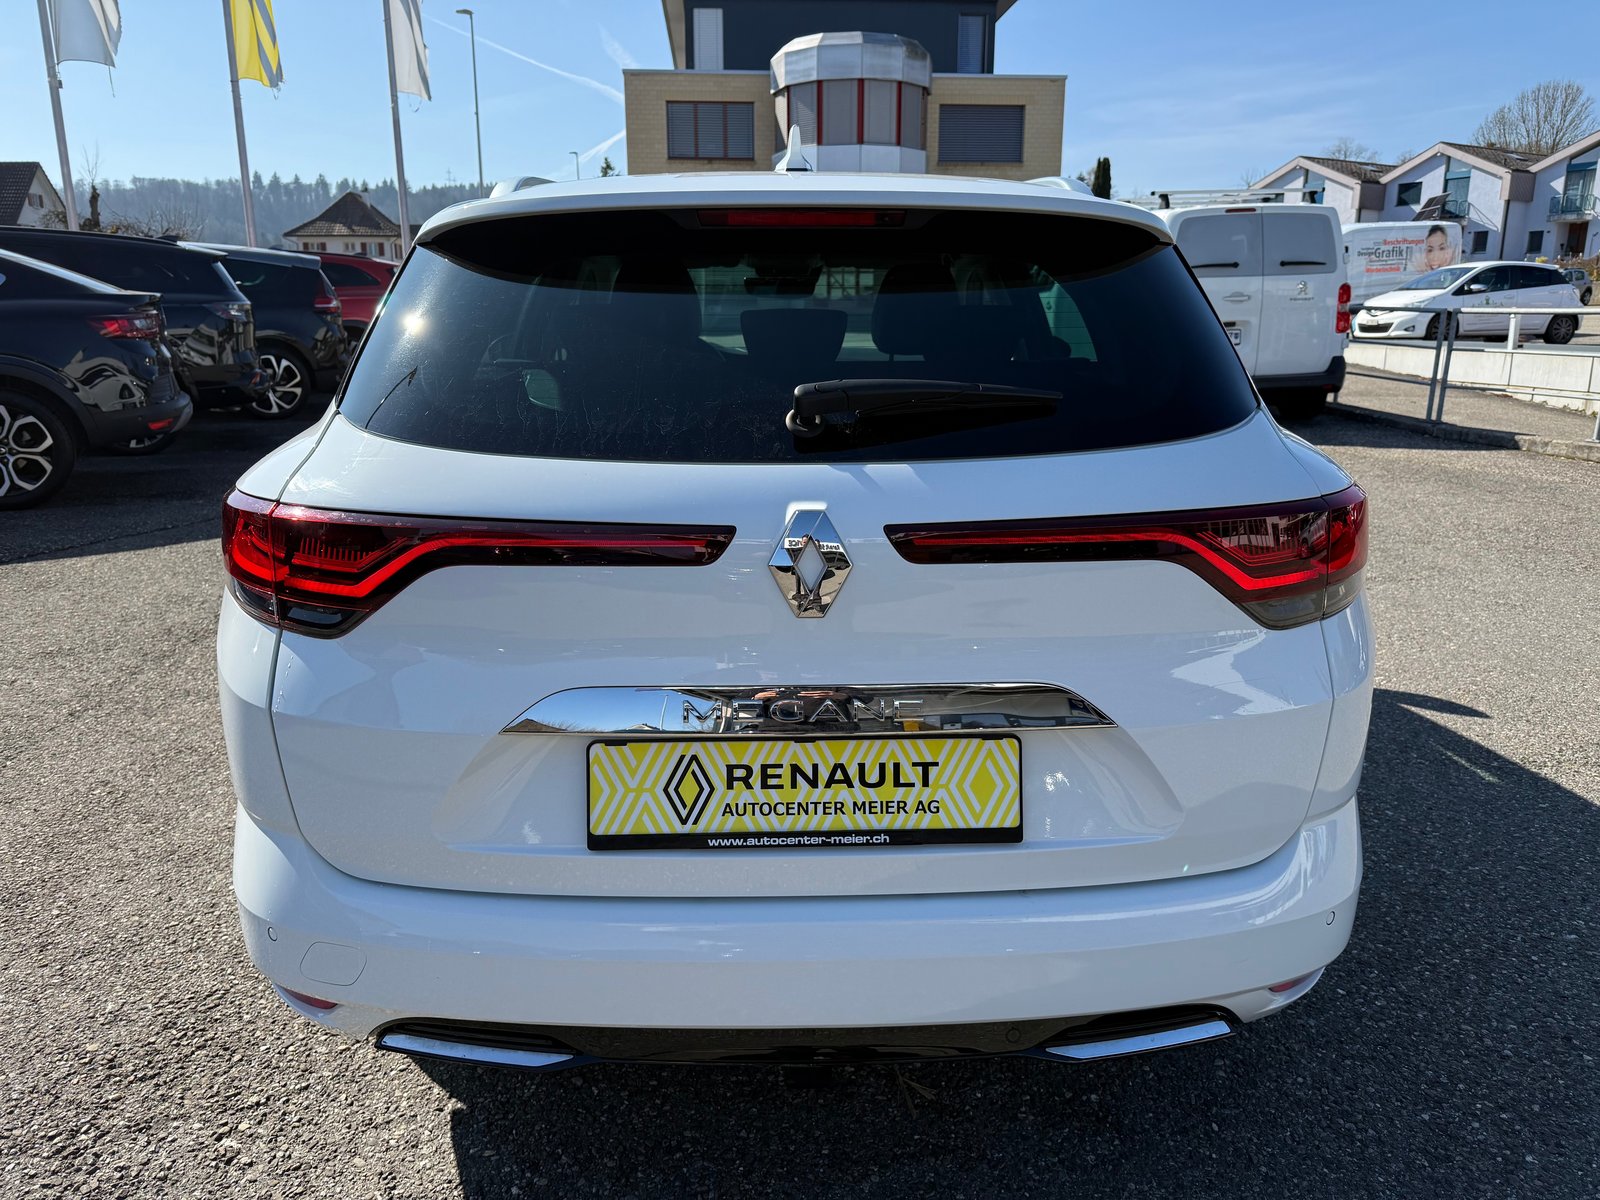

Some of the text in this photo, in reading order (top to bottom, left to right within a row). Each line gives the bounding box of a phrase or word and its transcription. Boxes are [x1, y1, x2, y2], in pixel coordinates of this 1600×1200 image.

[1374, 246, 1403, 258] Grafik
[725, 762, 939, 790] RENAULT
[721, 799, 940, 817] AUTOCENTER MEIER AG
[708, 834, 890, 847] www.autocenter-meier.ch
